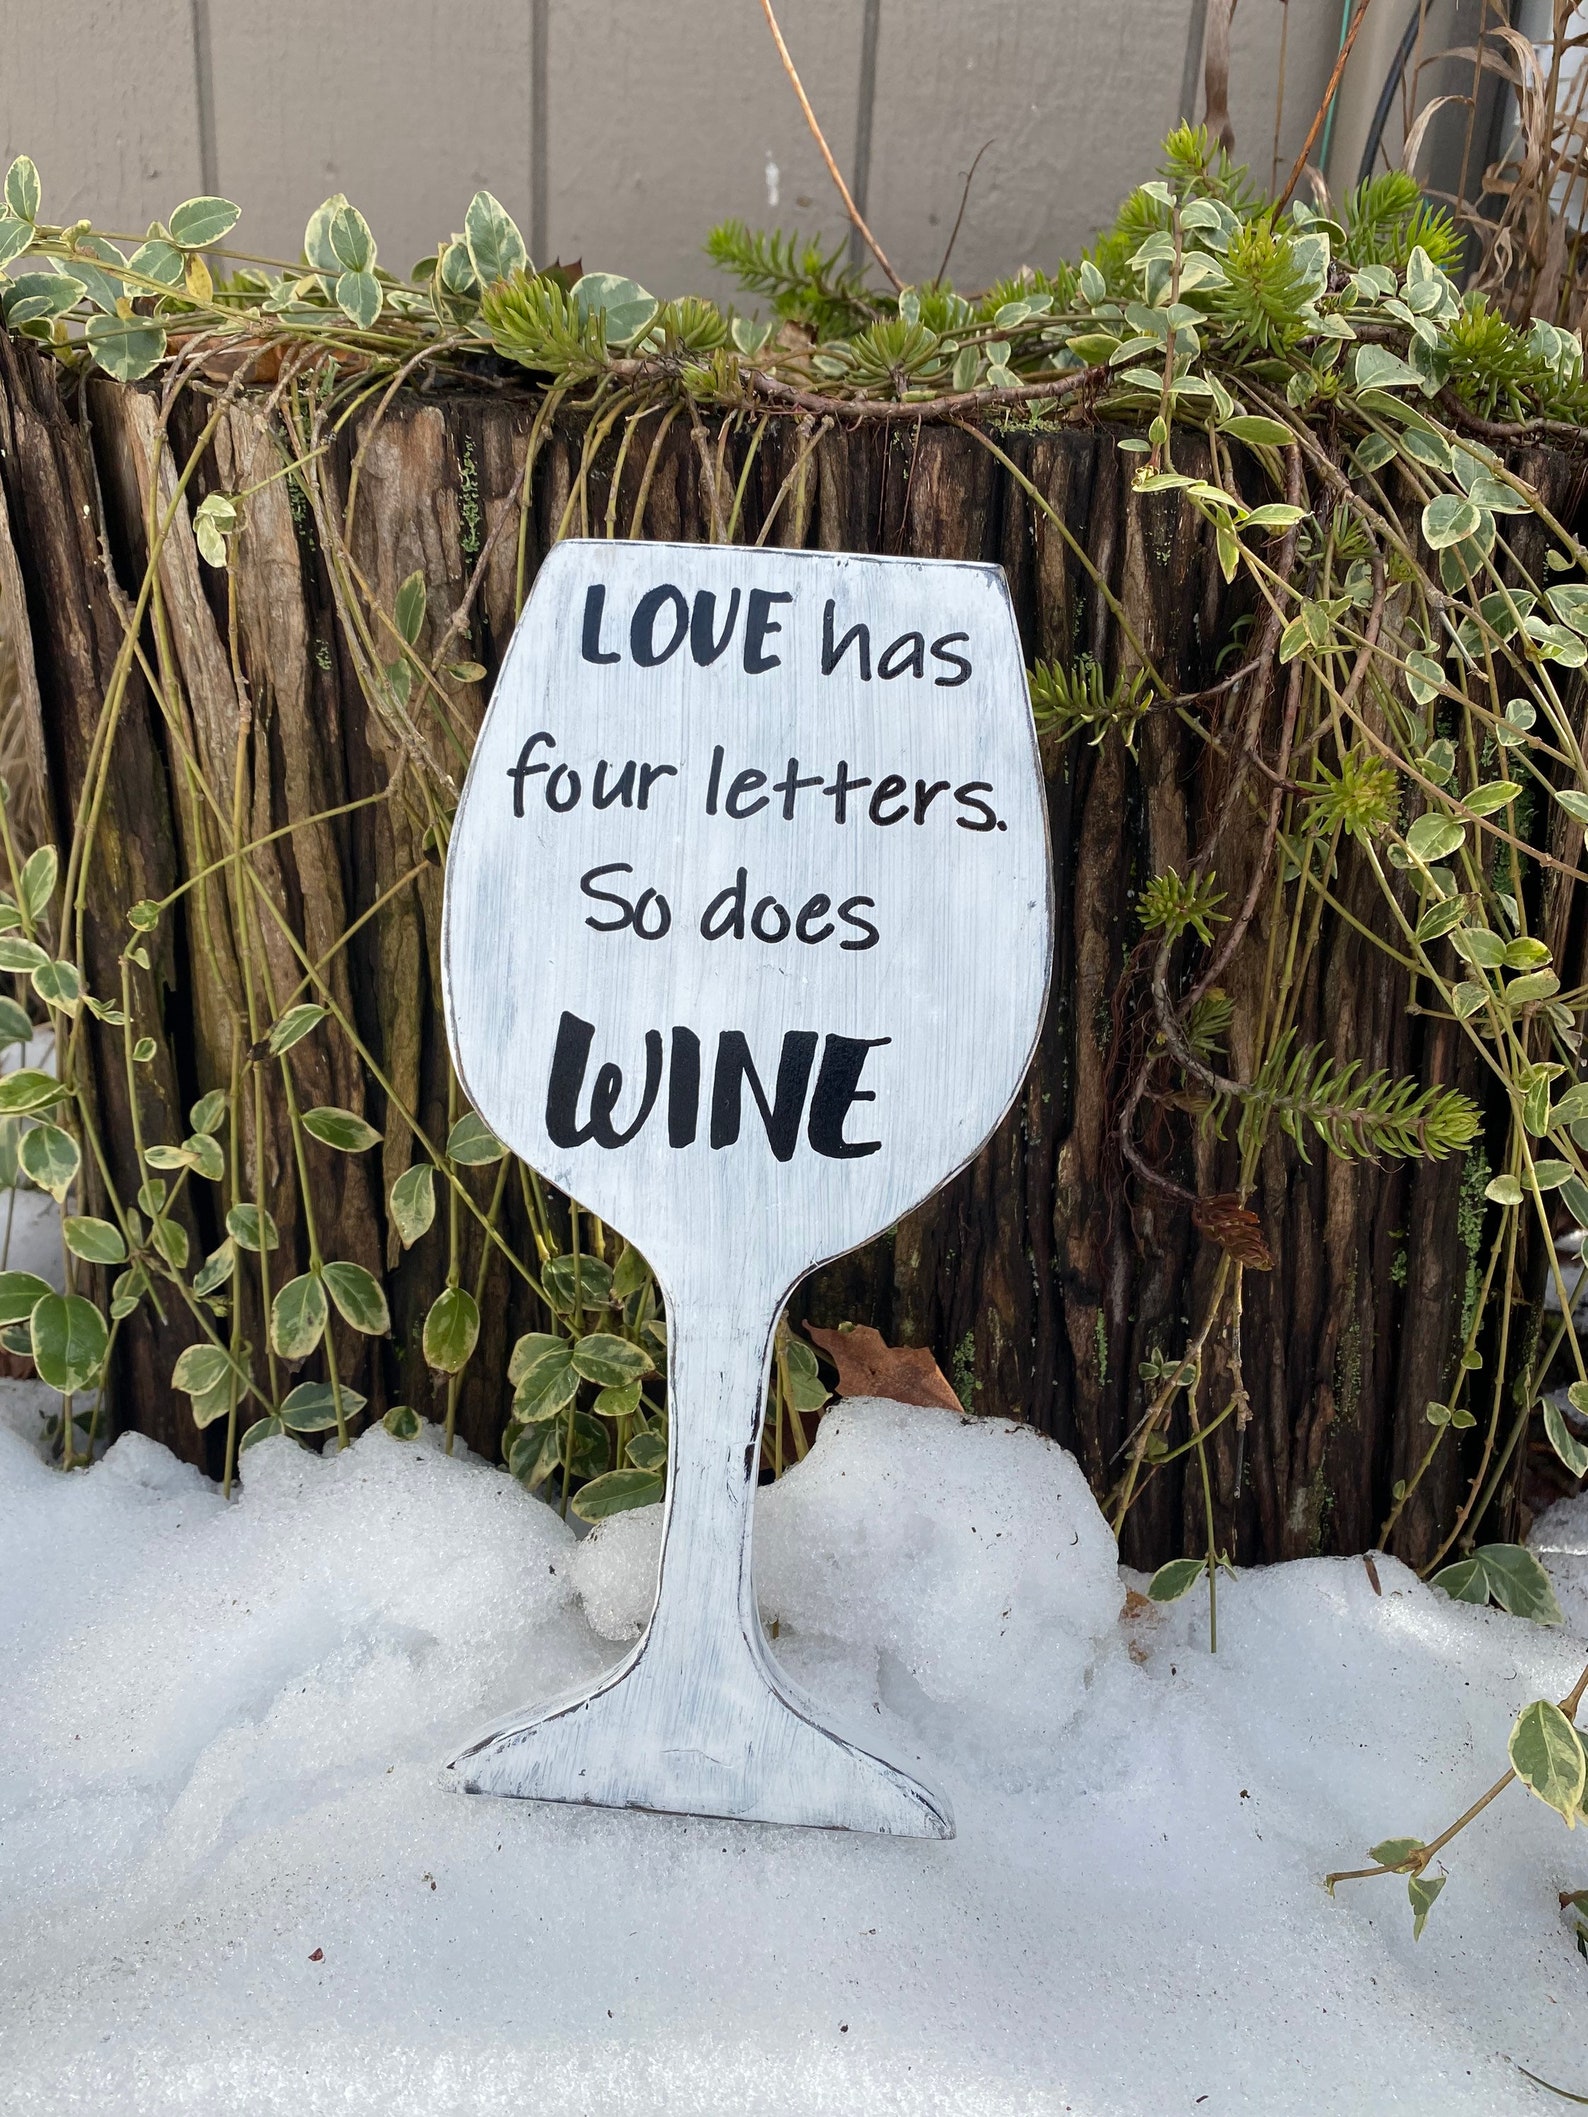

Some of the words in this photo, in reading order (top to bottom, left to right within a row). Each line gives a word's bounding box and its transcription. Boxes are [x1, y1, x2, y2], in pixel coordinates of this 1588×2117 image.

[581, 583, 793, 675] LOVE
[821, 598, 972, 687] has
[506, 731, 678, 818] four
[705, 744, 1008, 832] letters.
[580, 862, 672, 941] So
[700, 866, 880, 951] does
[545, 1010, 892, 1163] WINE
